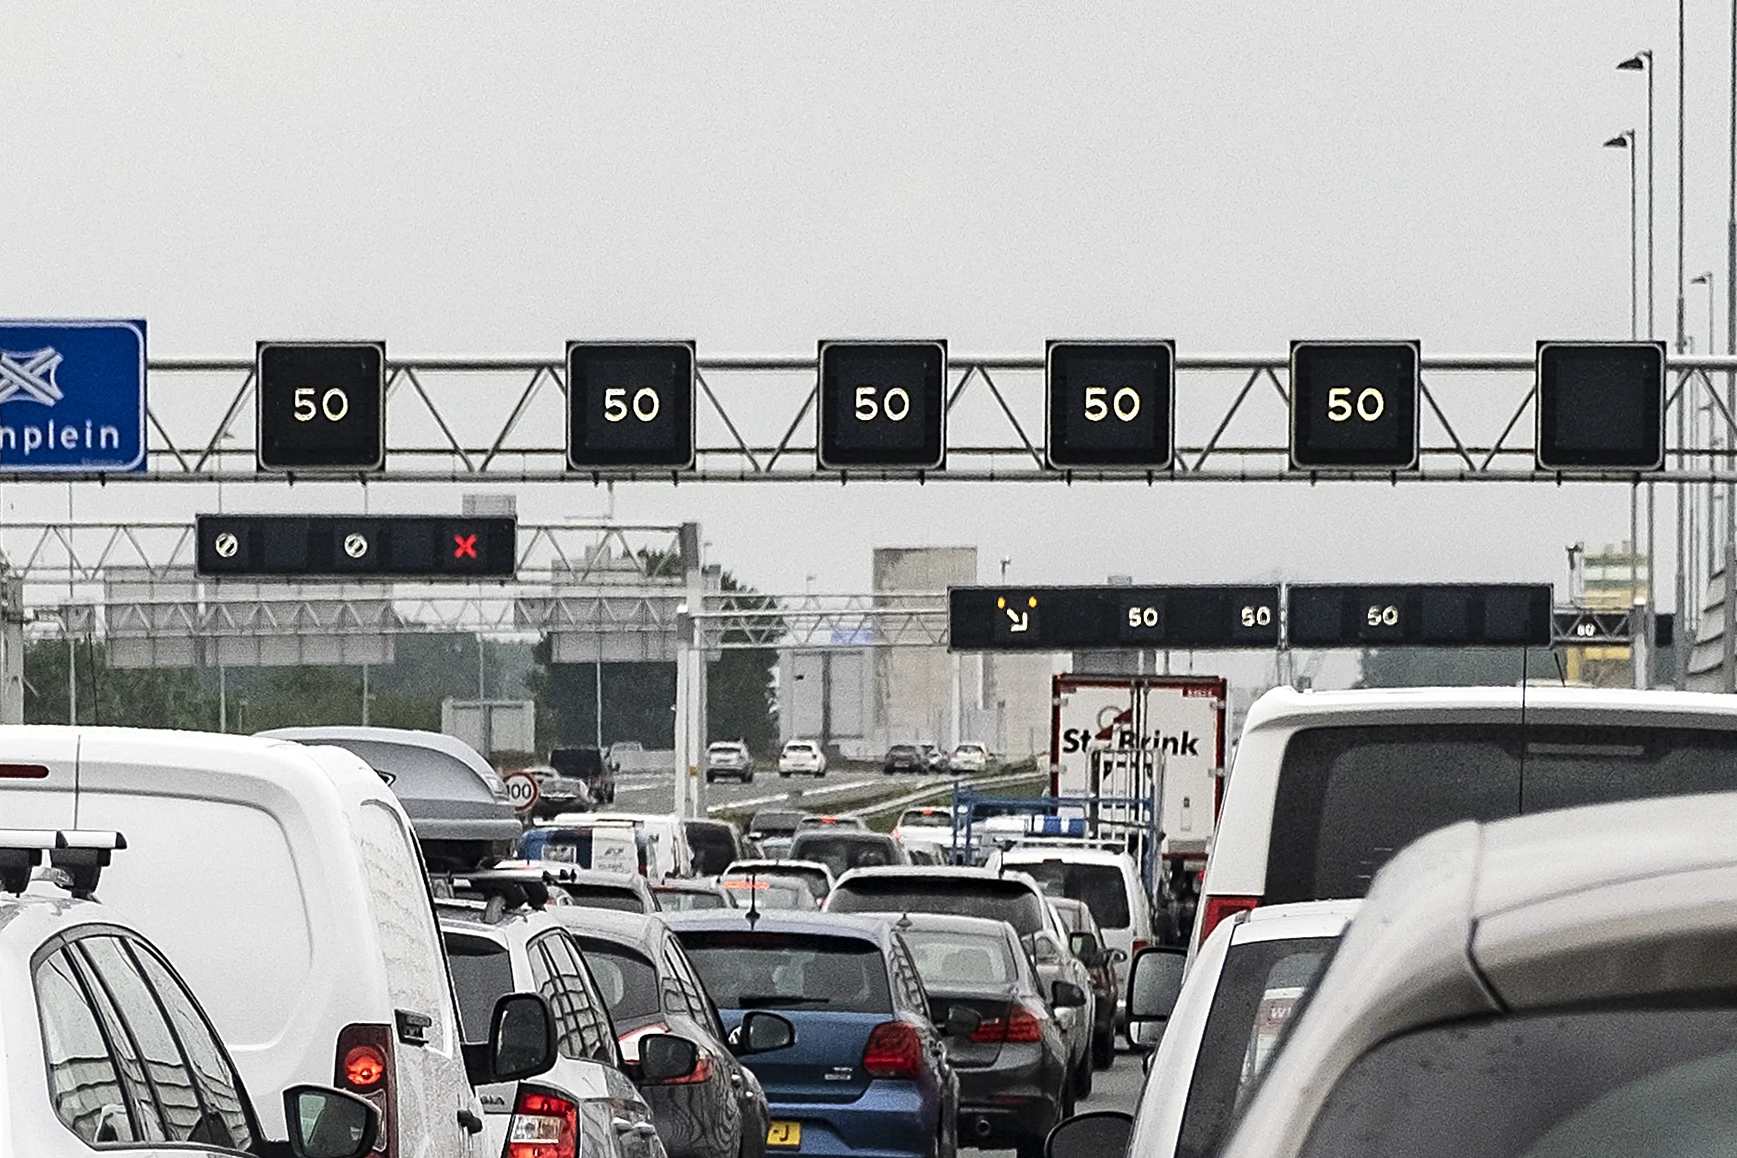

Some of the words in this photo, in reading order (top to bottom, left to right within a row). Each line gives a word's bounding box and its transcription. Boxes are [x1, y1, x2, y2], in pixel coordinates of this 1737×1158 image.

[293, 387, 349, 422] 50
[604, 387, 661, 422] 50
[854, 386, 910, 421] 50
[1084, 386, 1141, 422] 50
[1327, 386, 1385, 422] 50
[1128, 606, 1158, 627] 50
[1241, 605, 1271, 627] 50
[1367, 604, 1399, 626] 50
